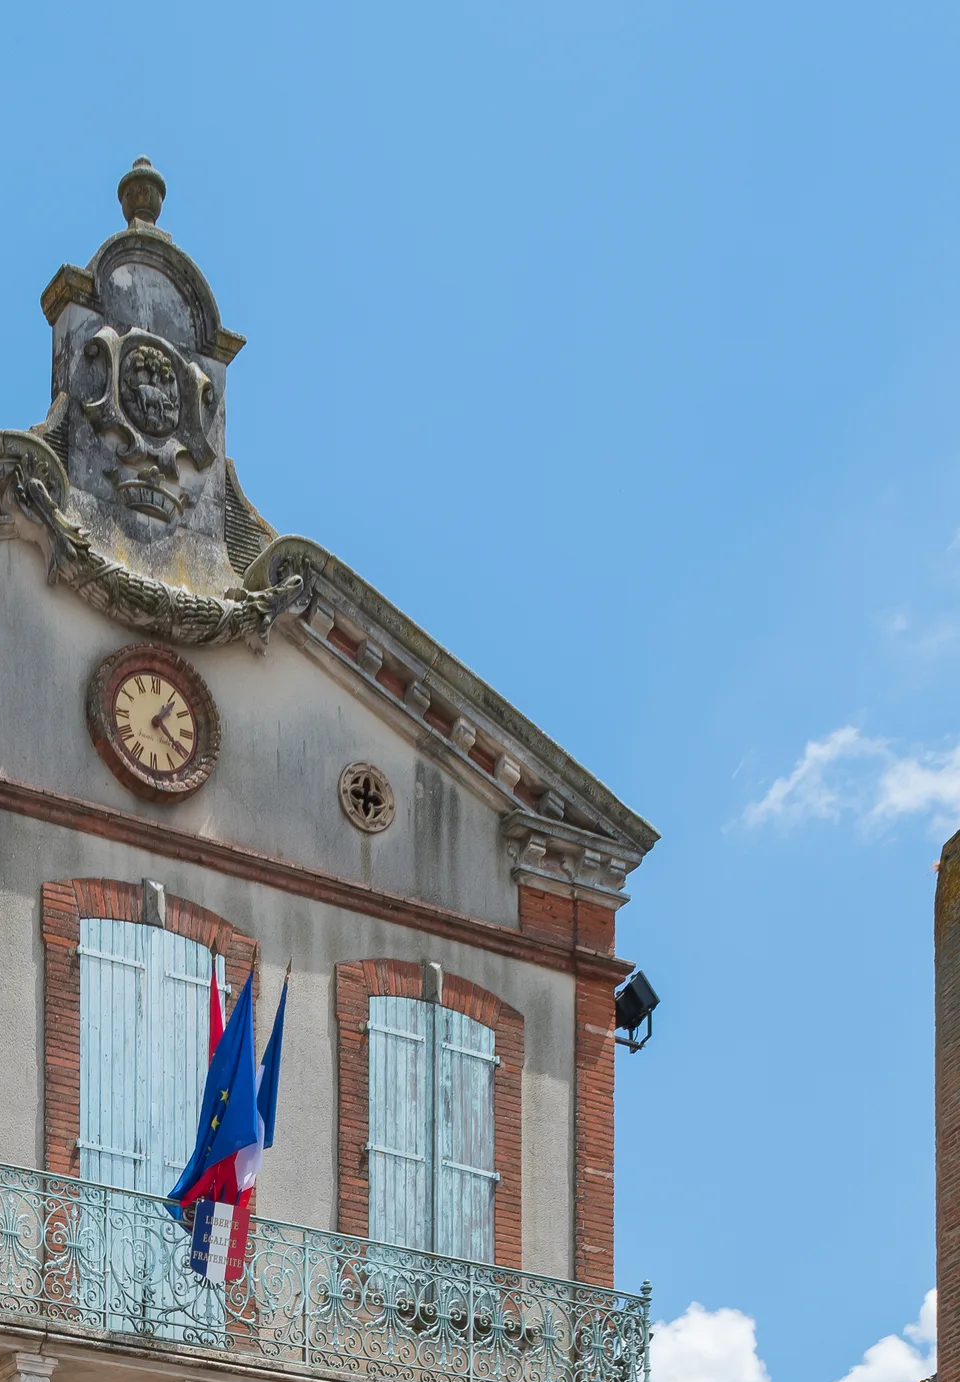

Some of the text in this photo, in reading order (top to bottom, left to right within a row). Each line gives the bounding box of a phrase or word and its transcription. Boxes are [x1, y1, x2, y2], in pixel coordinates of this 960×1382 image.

[134, 676, 146, 695] XI
[151, 676, 161, 695] XII
[120, 687, 134, 703] X
[167, 691, 176, 702] I
[176, 710, 189, 719] II
[118, 724, 134, 741] VIII
[180, 728, 193, 740] III
[131, 741, 144, 760] VII
[150, 752, 158, 770] VI
[166, 753, 175, 770] V
[205, 1215, 239, 1230] LIBERTÉ
[202, 1232, 237, 1248] ÉGALITÉ
[192, 1250, 242, 1268] FRATERNITÉ
